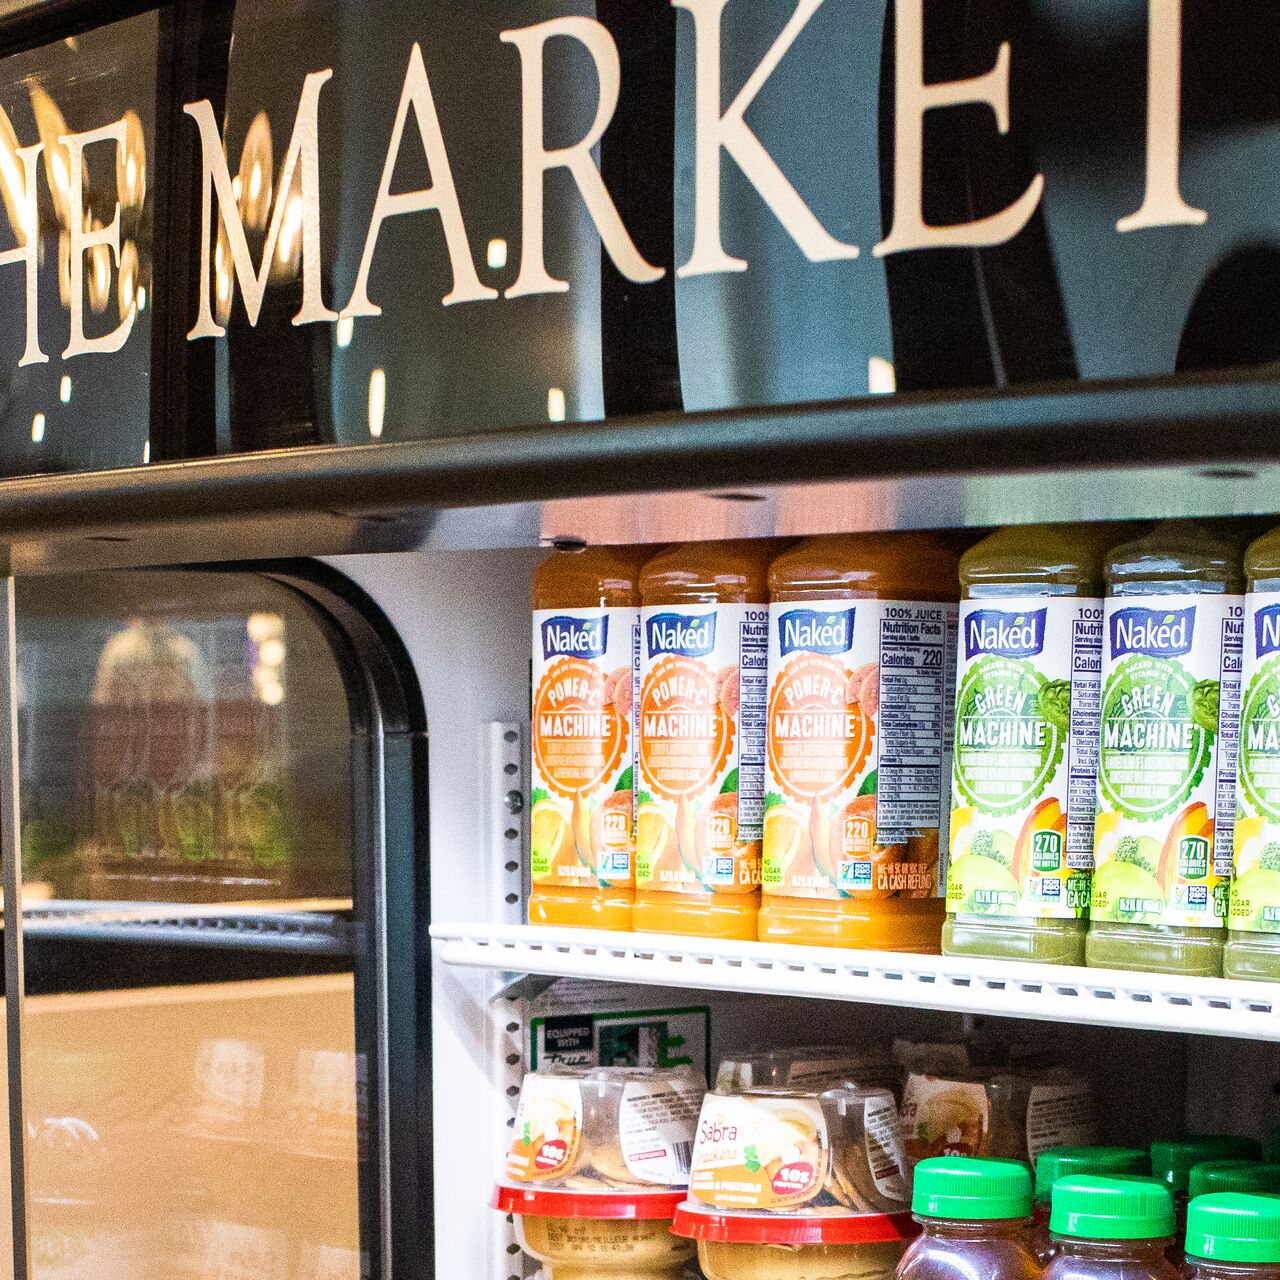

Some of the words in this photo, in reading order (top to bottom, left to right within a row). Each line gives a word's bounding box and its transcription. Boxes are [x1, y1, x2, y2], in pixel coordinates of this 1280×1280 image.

[182, 0, 1208, 341] MARKET
[885, 608, 912, 618] 100%
[915, 609, 942, 620] JUICE
[546, 621, 603, 652] Naked
[647, 621, 709, 652] Naked
[784, 616, 845, 647] Naked
[882, 621, 919, 634] Nutrition
[969, 619, 1036, 650] Naked
[1116, 619, 1185, 650] Naked
[881, 652, 915, 666] Calories
[922, 650, 942, 666] 220
[540, 715, 611, 737] MACHINE
[644, 715, 718, 738] MACHINE
[775, 714, 856, 738] MACHINE
[960, 720, 1046, 746] MACHINE
[1105, 722, 1193, 750] MACHINE
[846, 821, 869, 837] 220
[1035, 834, 1057, 851] 270
[1182, 840, 1204, 859] 270
[546, 1027, 590, 1040] EQUIPPED
[701, 1120, 737, 1143] Sabra
[780, 1168, 809, 1184] 10g
